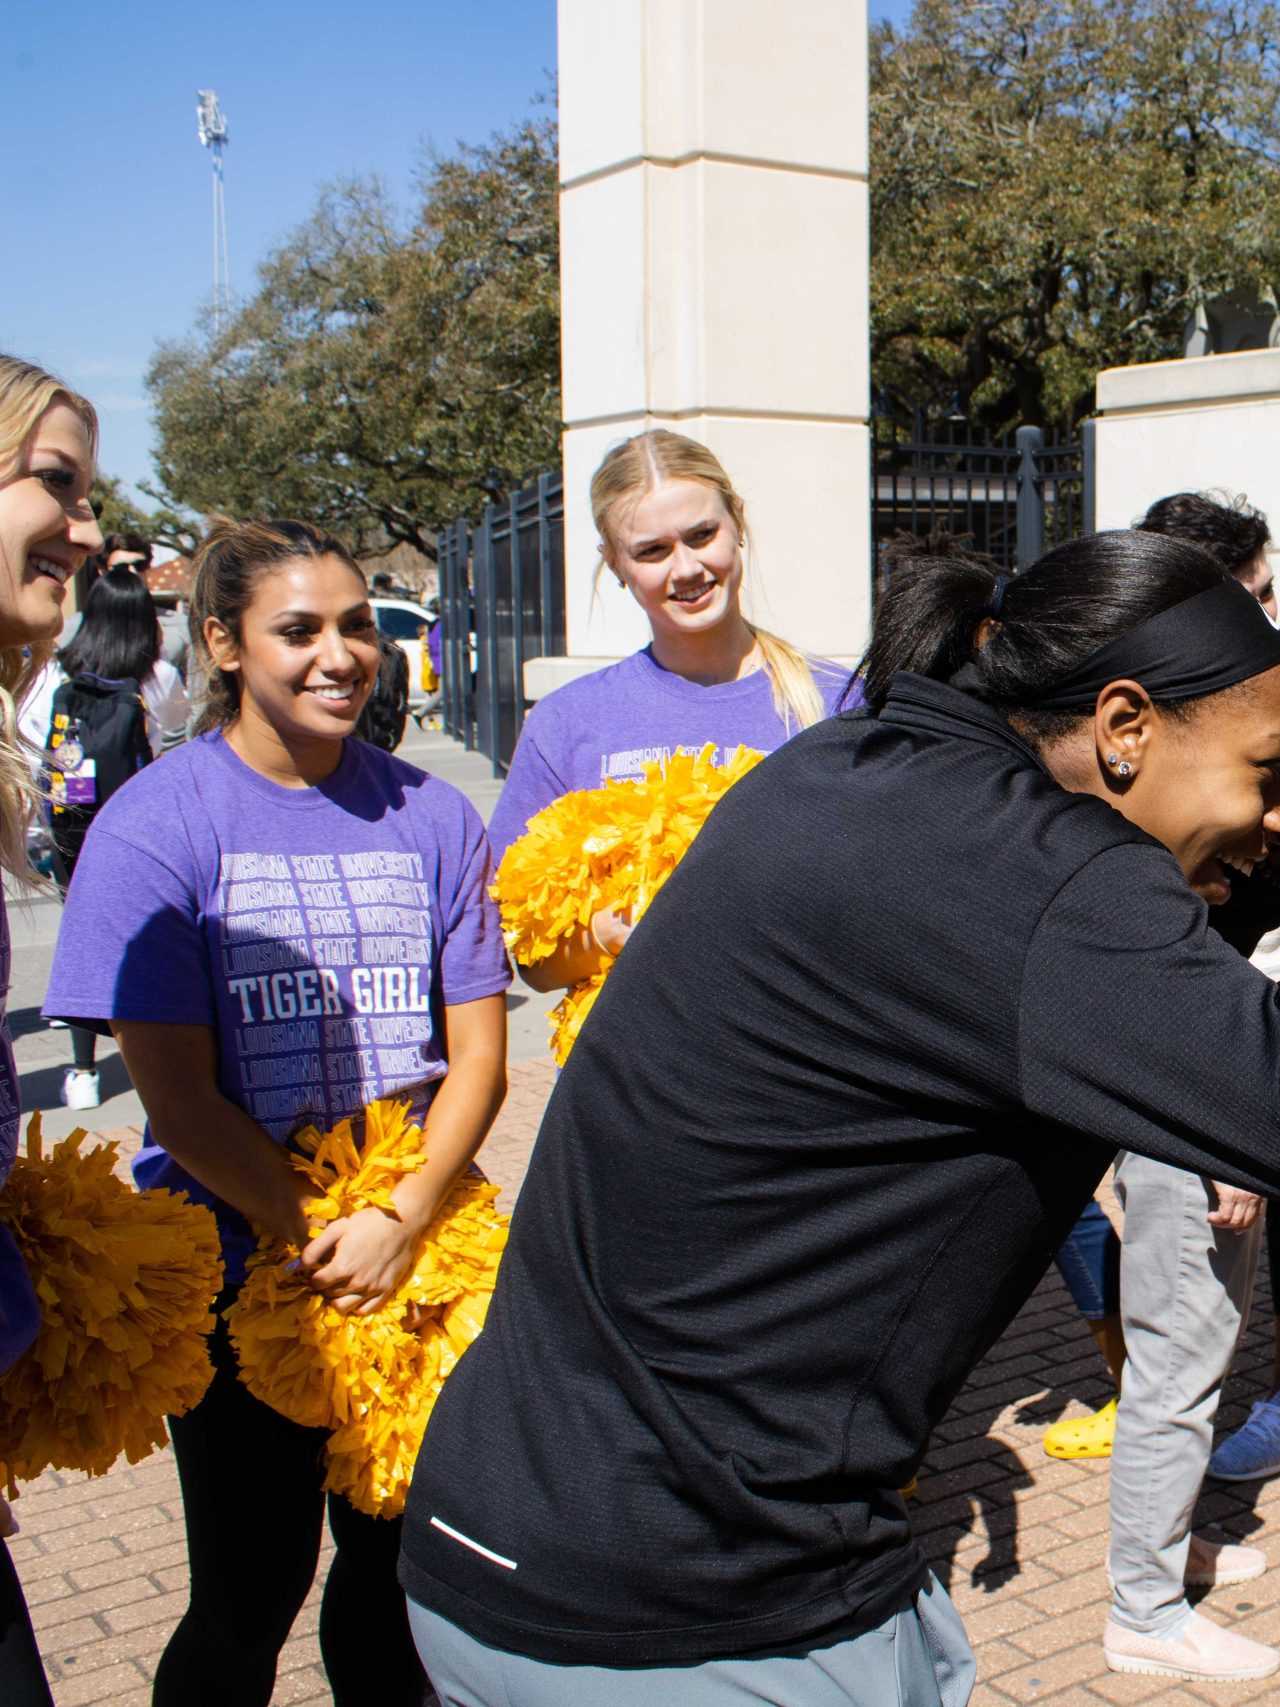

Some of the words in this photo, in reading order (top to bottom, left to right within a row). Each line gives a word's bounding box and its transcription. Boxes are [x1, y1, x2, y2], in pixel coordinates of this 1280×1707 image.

[291, 854, 340, 881] STATE
[299, 882, 349, 908] STATE
[306, 908, 357, 935] STATE
[223, 939, 311, 977] LOUISIANA
[311, 937, 359, 966] STATE
[228, 968, 343, 1023] TIGER
[351, 966, 432, 1014] GIRL
[235, 1020, 321, 1056] LOUISIANA
[323, 1017, 371, 1048] STATE
[240, 1053, 324, 1089] LOUISIANA
[327, 1049, 377, 1081] STATE
